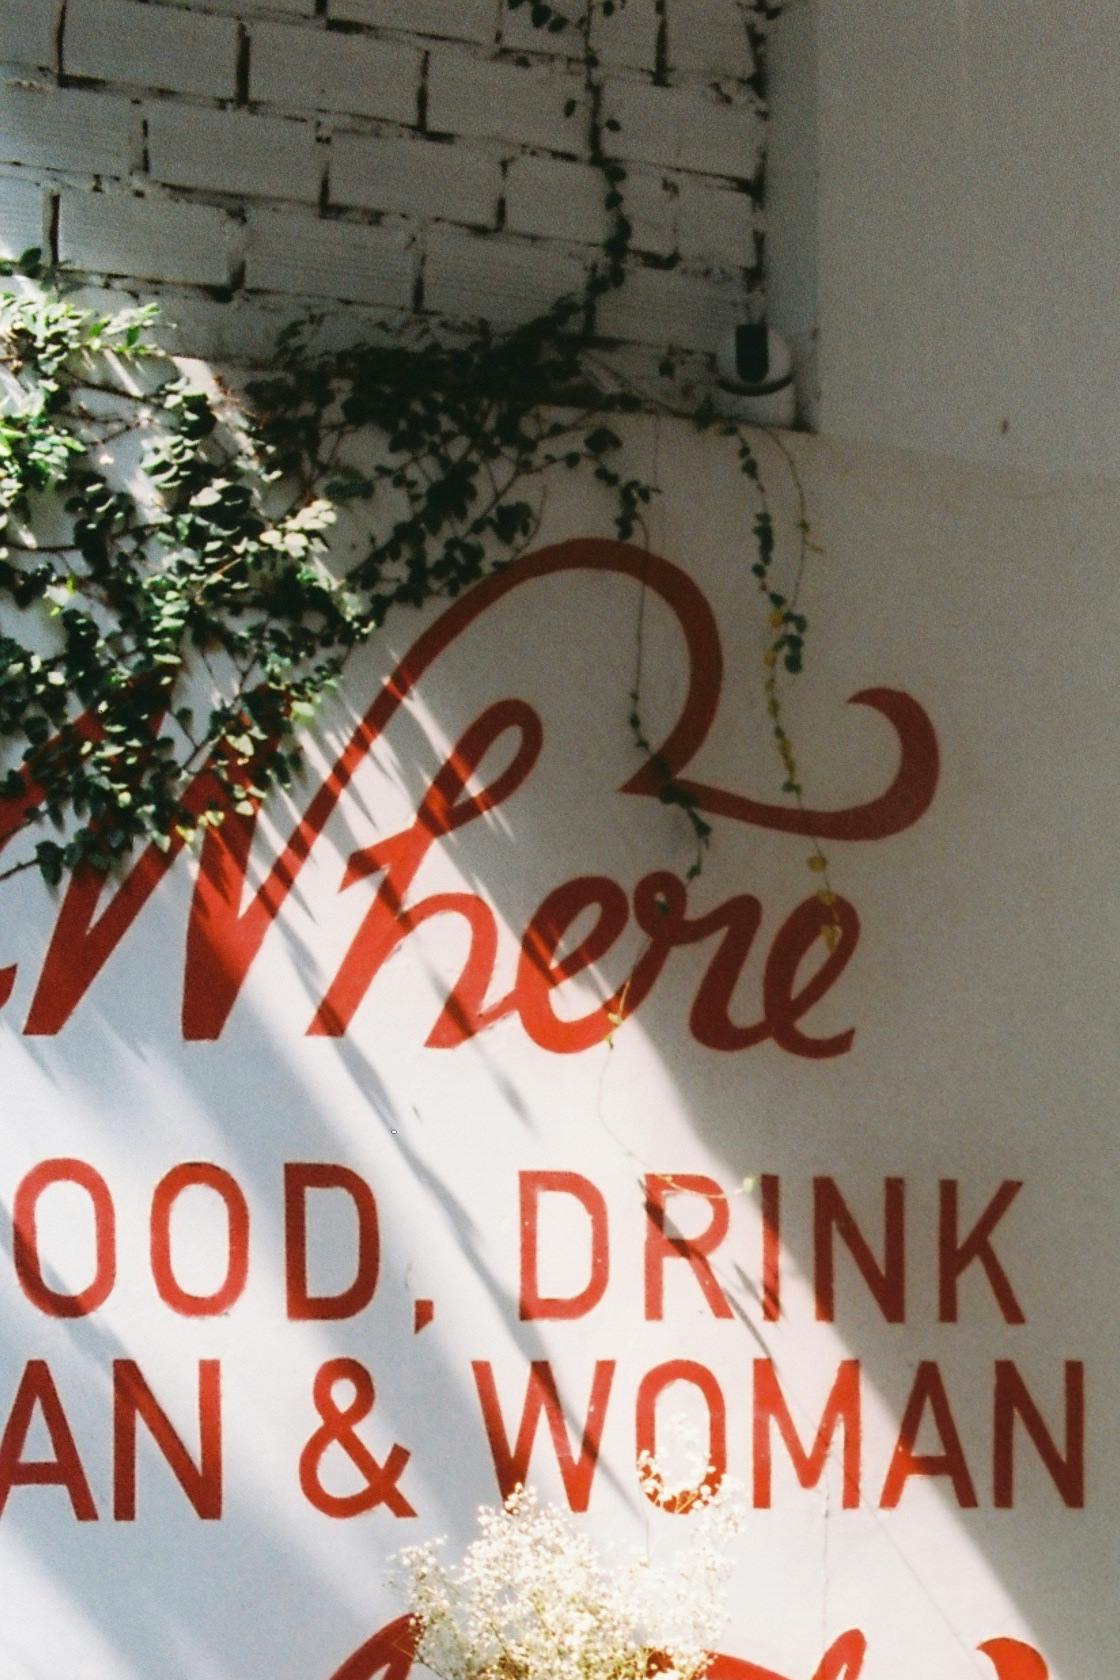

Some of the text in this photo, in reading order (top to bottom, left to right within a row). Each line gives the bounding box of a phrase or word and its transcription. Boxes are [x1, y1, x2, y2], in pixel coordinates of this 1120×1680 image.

[0, 538, 940, 1060] Where
[517, 1168, 1026, 1326] DRINK
[298, 1356, 418, 1520] &
[470, 1356, 1086, 1517] WOMAN
